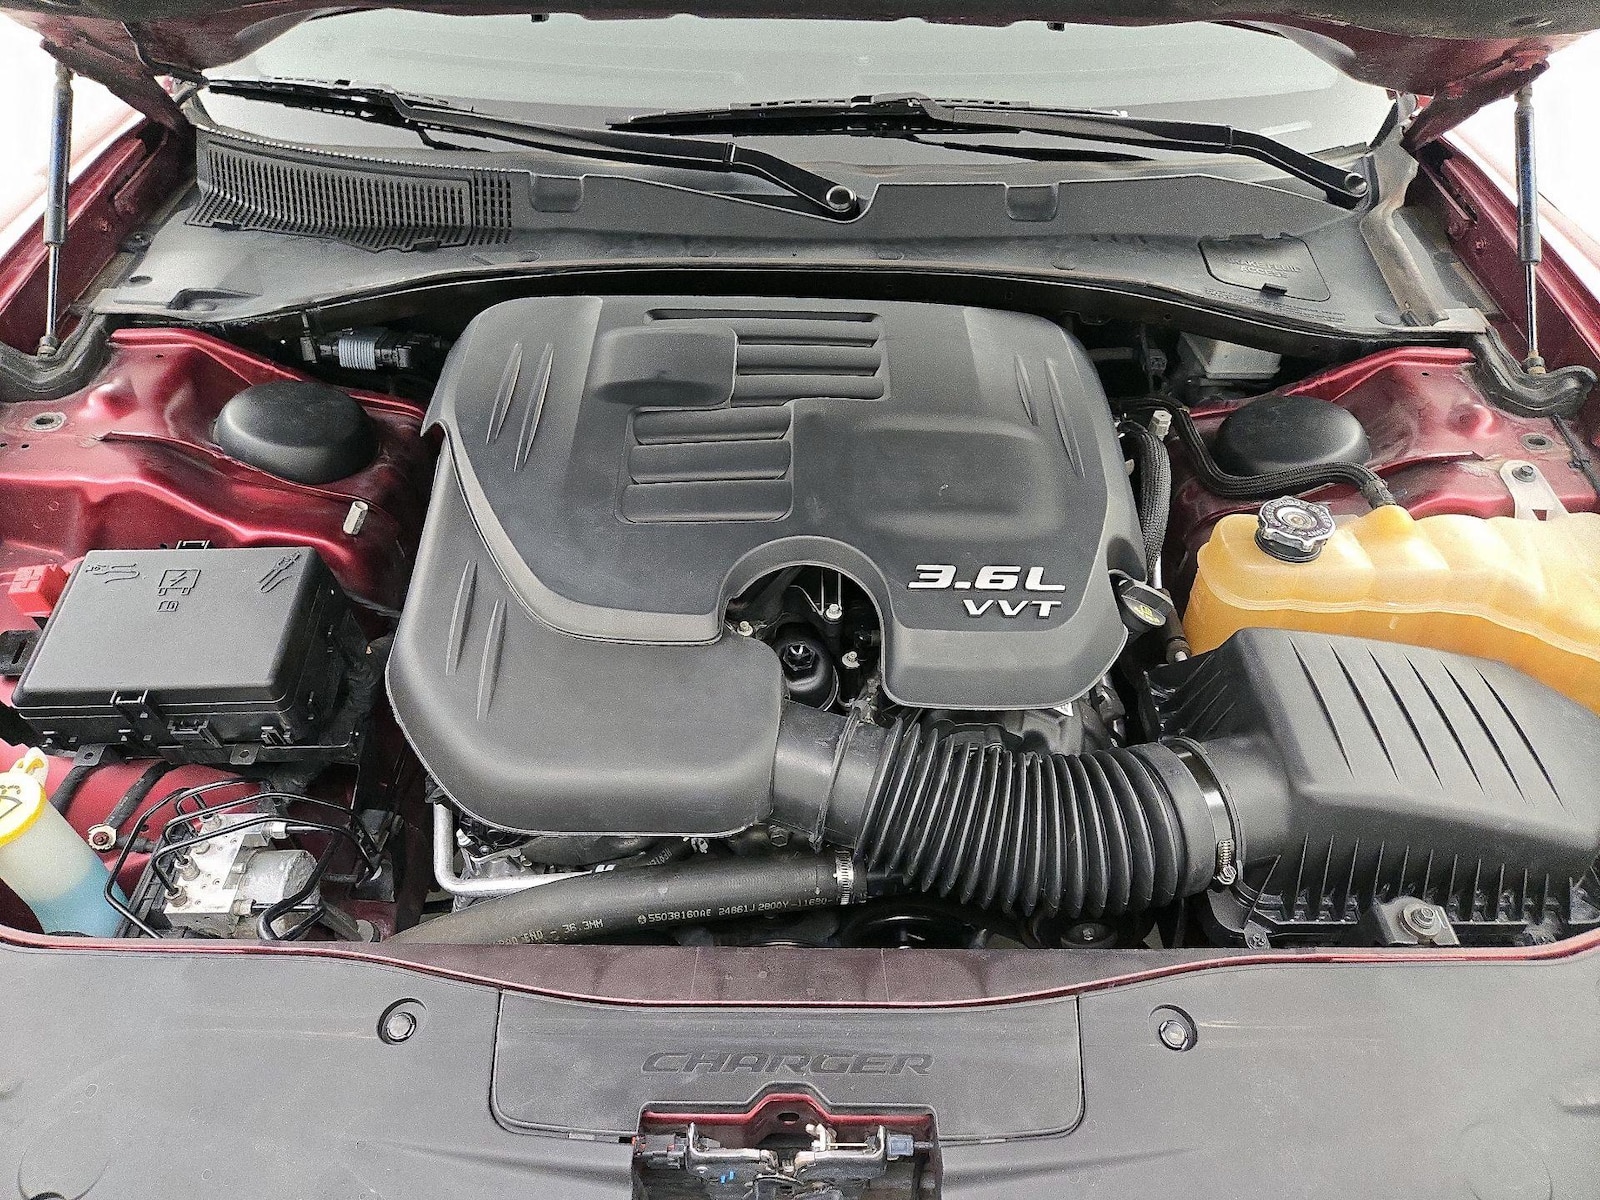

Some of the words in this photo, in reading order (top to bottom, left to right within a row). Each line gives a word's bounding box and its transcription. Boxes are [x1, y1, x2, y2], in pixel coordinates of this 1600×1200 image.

[907, 564, 1067, 591] 3.6L
[962, 599, 1063, 619] VVT
[641, 1051, 936, 1076] CHARGER
